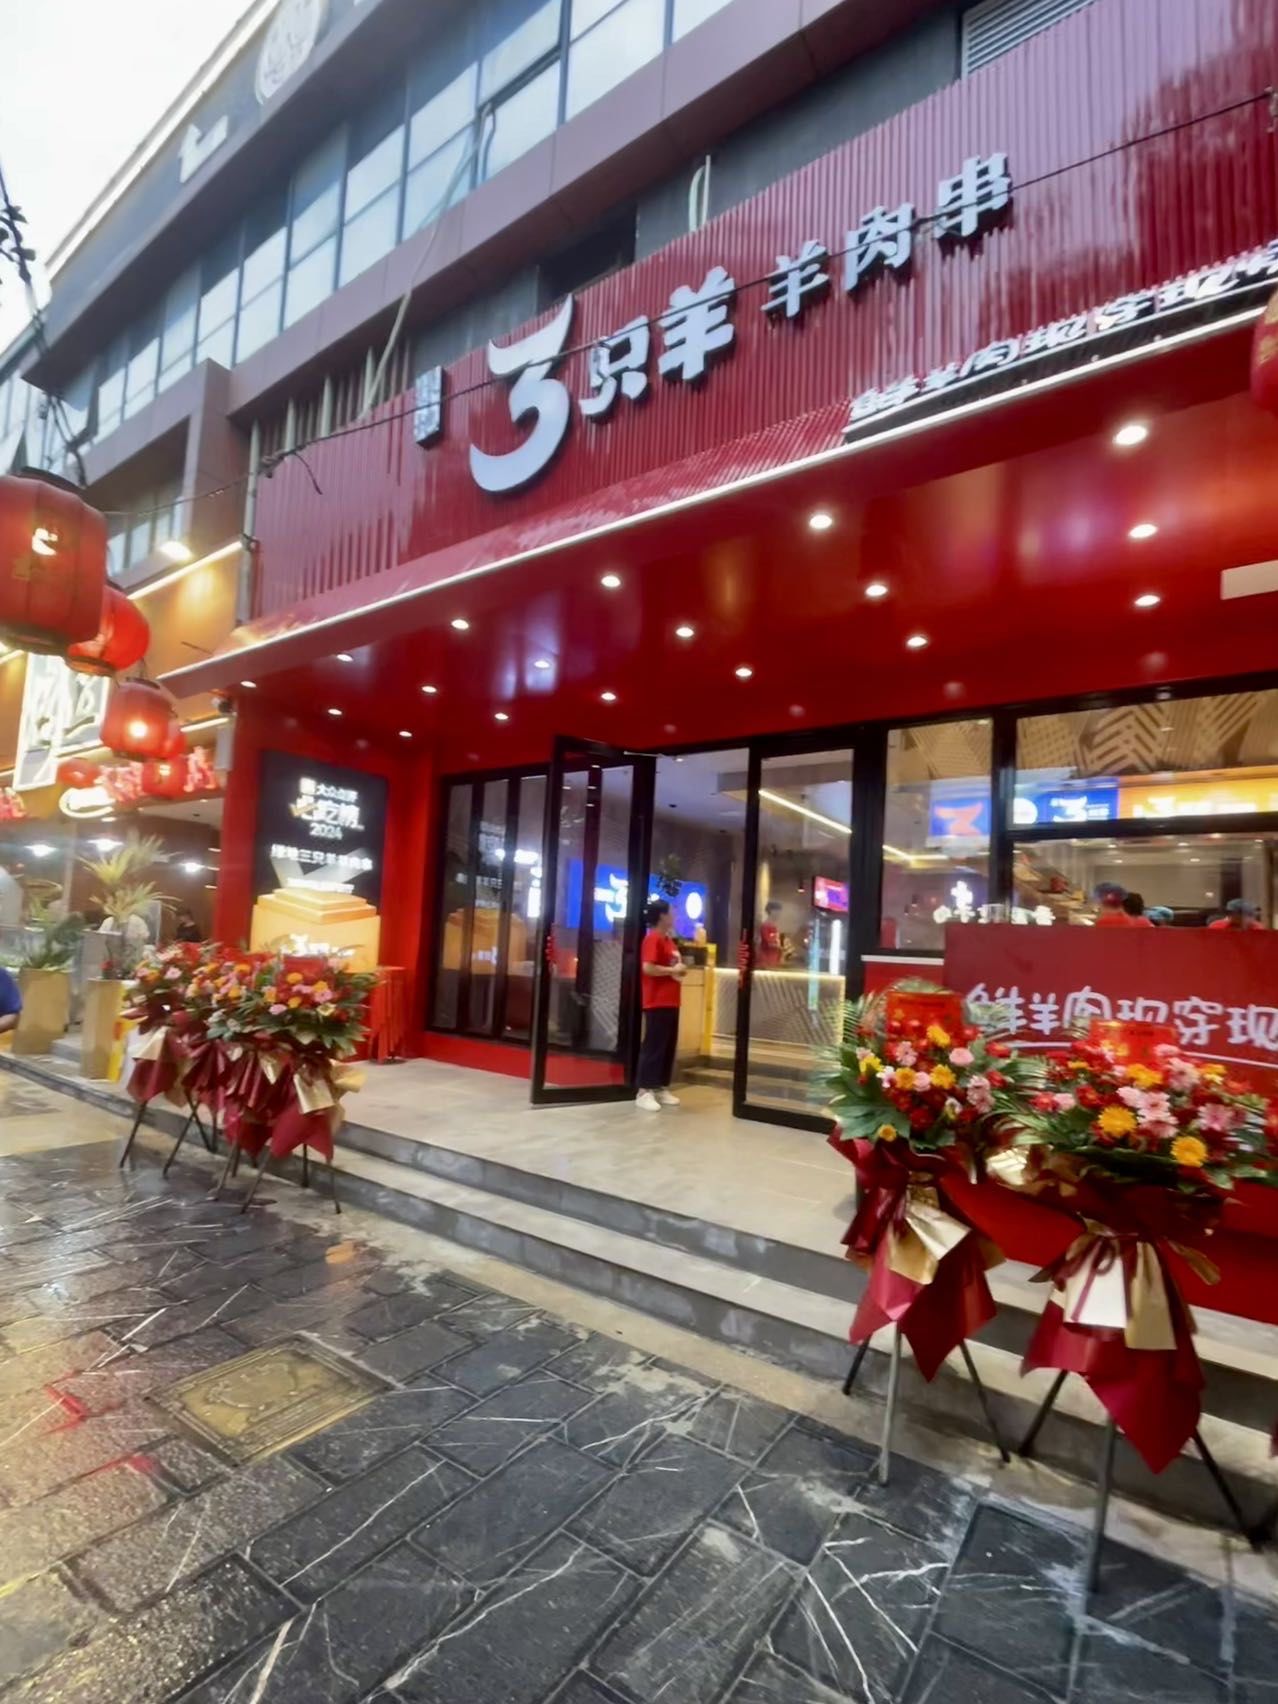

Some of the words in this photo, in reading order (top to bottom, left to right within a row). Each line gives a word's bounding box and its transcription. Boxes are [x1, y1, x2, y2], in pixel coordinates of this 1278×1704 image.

[761, 152, 1012, 318] 羊肉串
[309, 822, 343, 840] 2024
